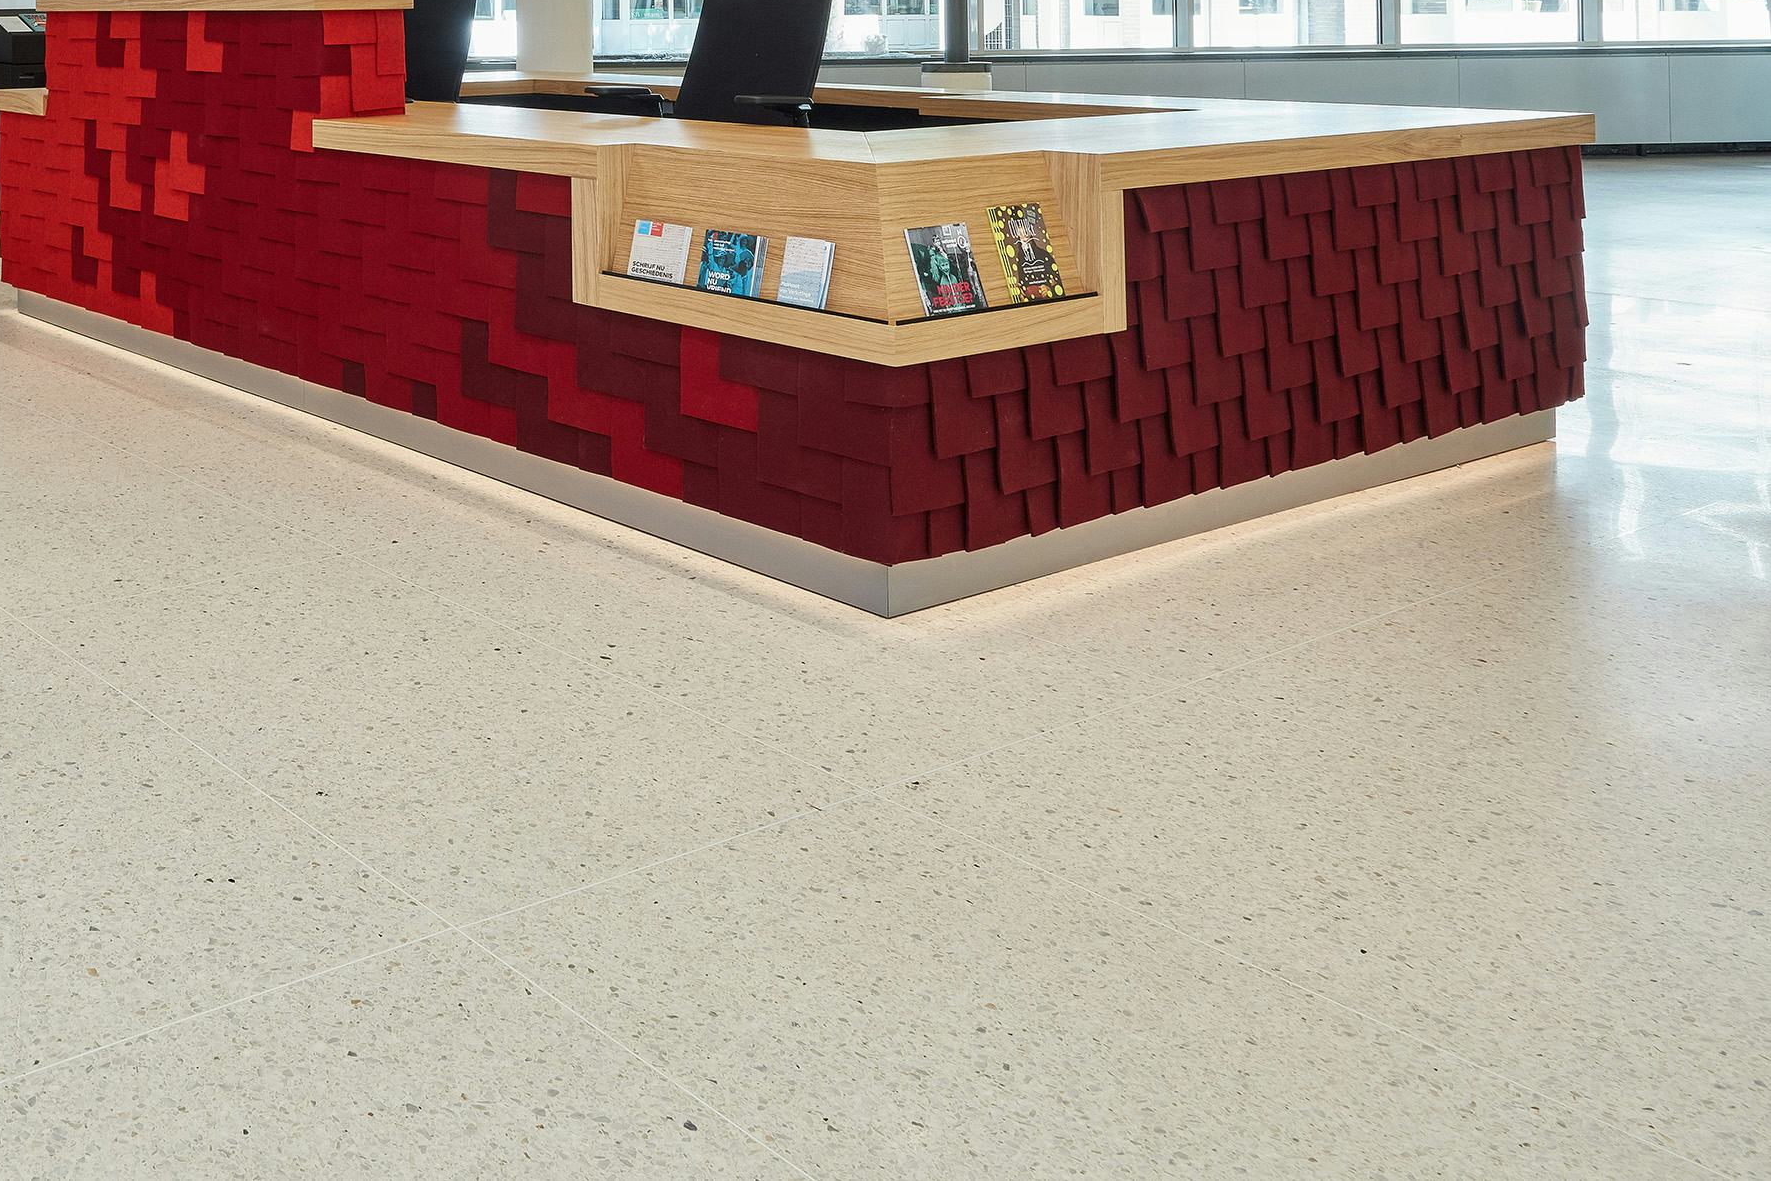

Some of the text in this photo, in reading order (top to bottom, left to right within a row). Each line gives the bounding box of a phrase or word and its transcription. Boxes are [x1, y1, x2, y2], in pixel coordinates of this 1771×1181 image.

[632, 260, 666, 272] SCHRIJF NU
[631, 266, 674, 280] GESCHIEDENIS
[708, 271, 731, 281] WORD
[707, 277, 718, 286] NU
